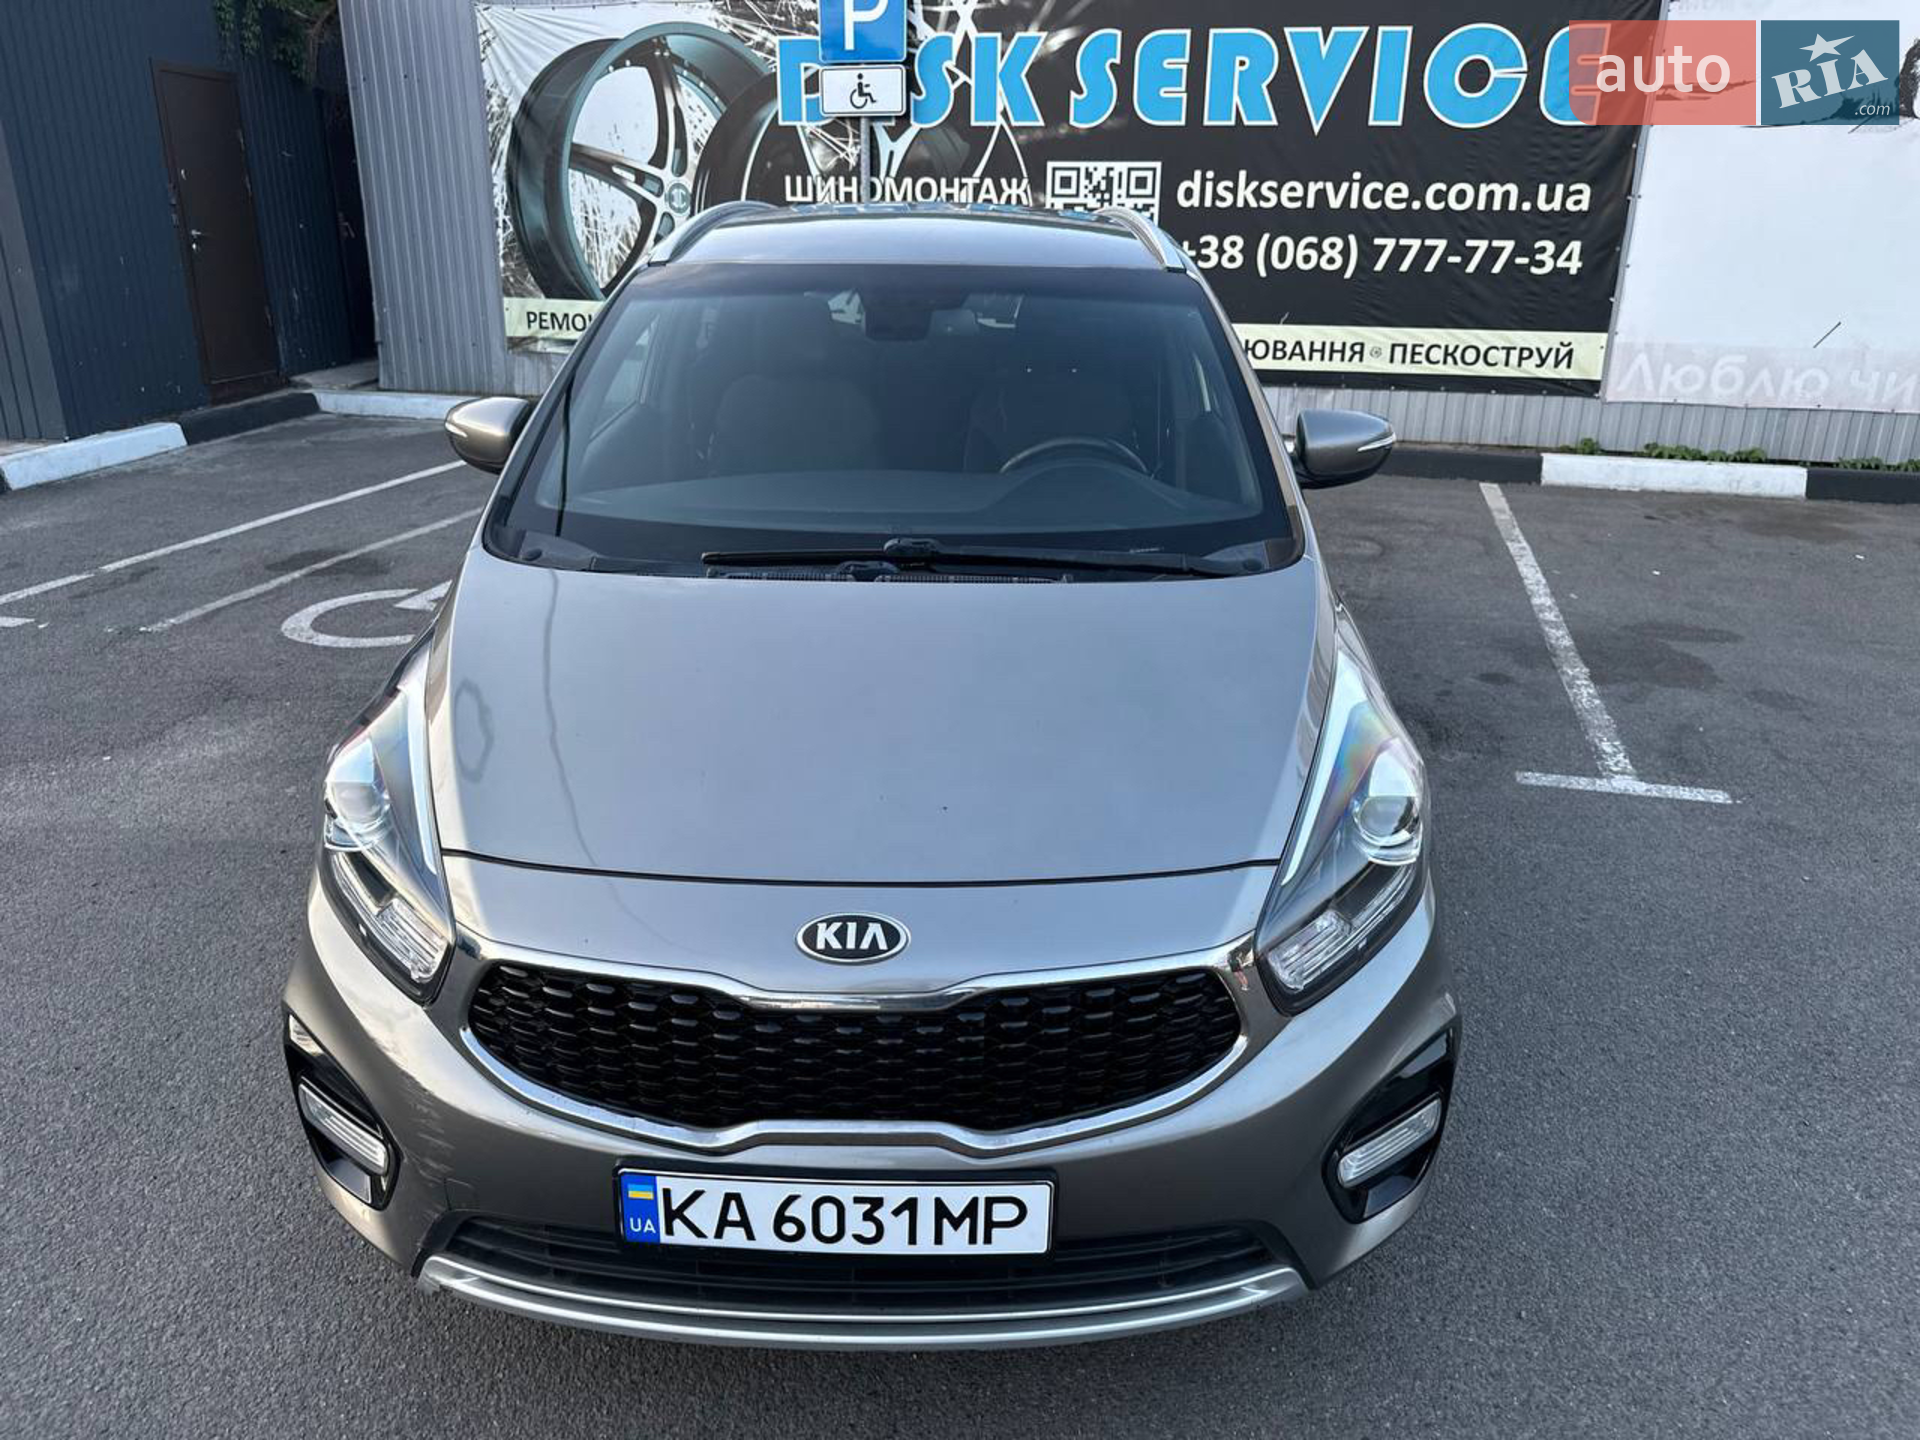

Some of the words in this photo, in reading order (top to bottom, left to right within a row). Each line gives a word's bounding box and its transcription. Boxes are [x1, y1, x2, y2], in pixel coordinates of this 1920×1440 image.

[778, 31, 1049, 128] DSK
[1069, 22, 1612, 135] SERVICE
[1176, 169, 1592, 212] diskservice.com.ua
[1182, 234, 1245, 270] +38
[1256, 232, 1358, 279] (068)
[1372, 236, 1583, 276] 777-77-34
[1389, 341, 1574, 369] ПЕСКОСТРУЙ
[1617, 352, 1830, 398] Люблю
[816, 921, 889, 951] KIA
[629, 1217, 656, 1234] UA
